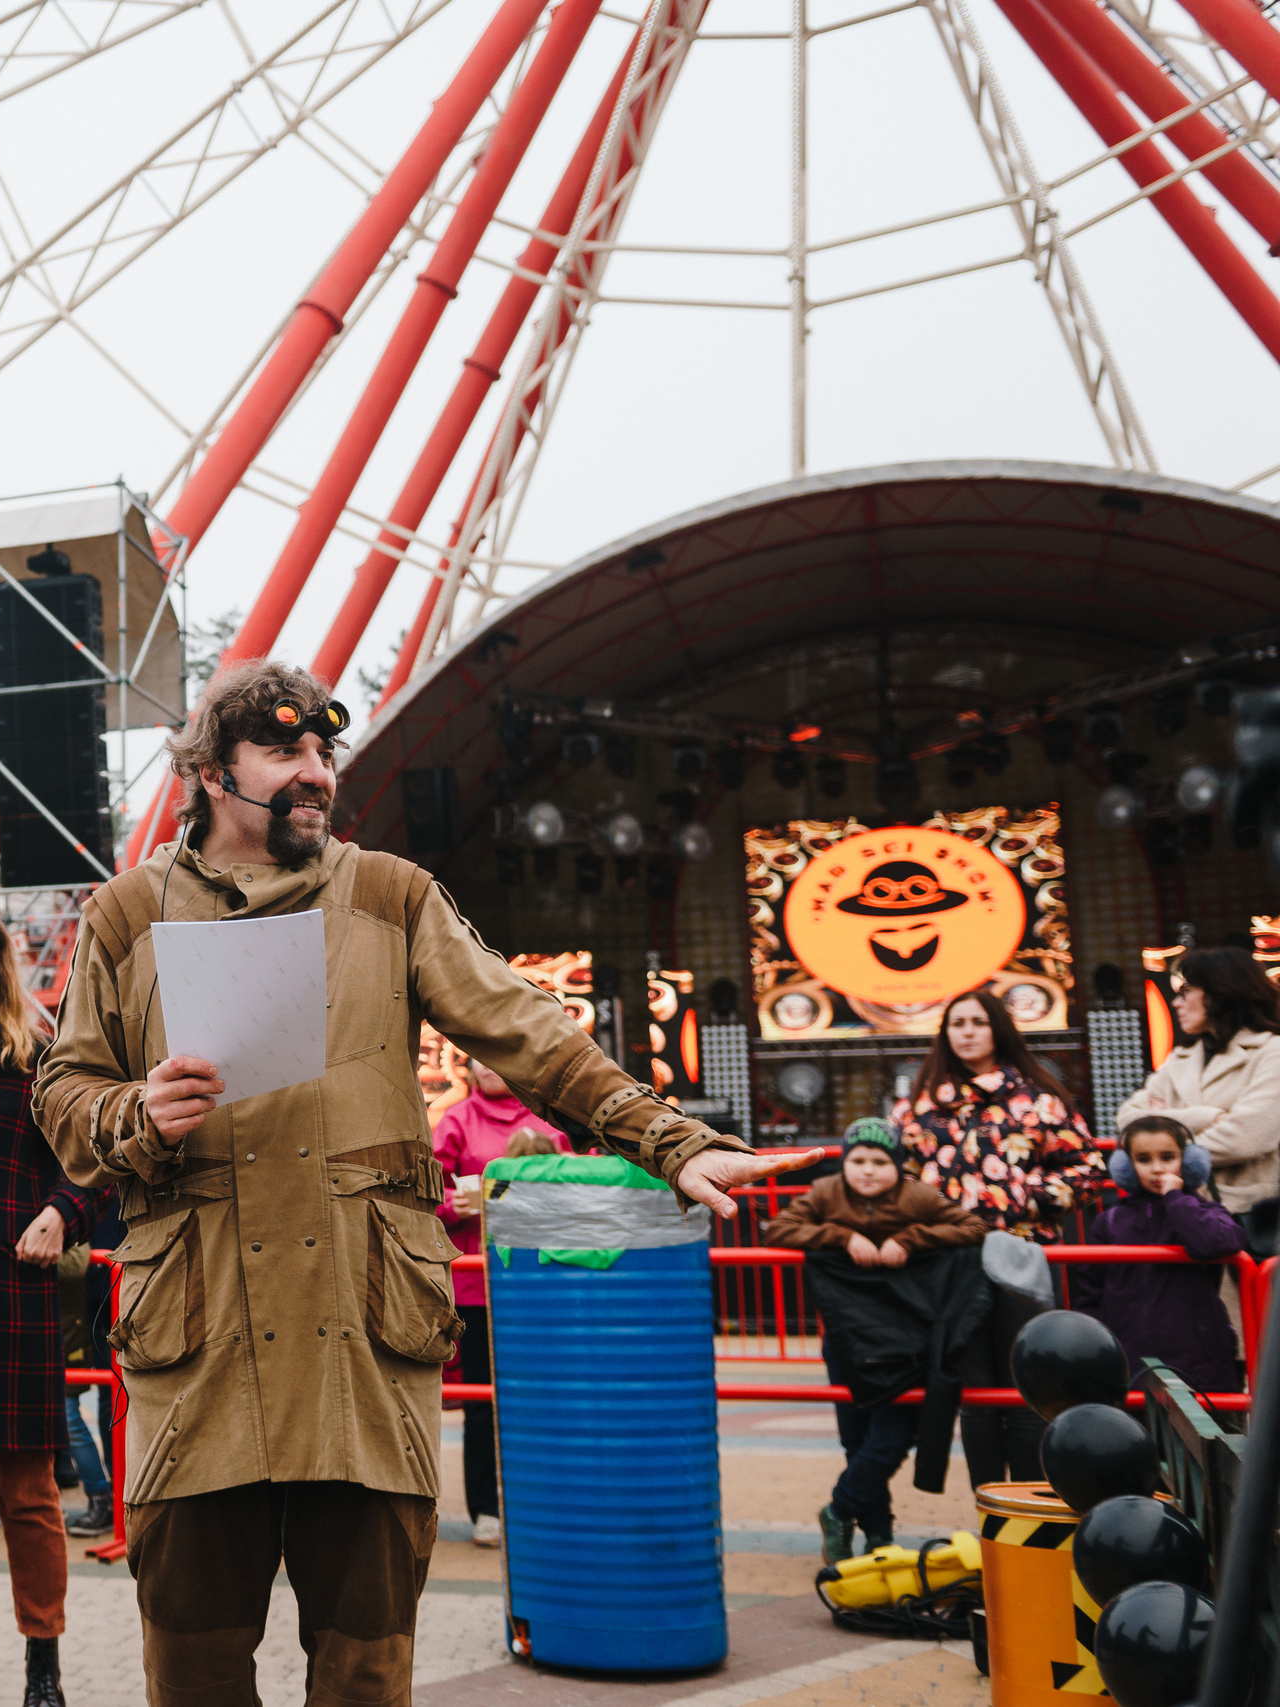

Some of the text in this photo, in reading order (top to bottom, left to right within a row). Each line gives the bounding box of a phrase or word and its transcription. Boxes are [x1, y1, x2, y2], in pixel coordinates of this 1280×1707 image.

[811, 841, 994, 911] MAD SCI SHOW
